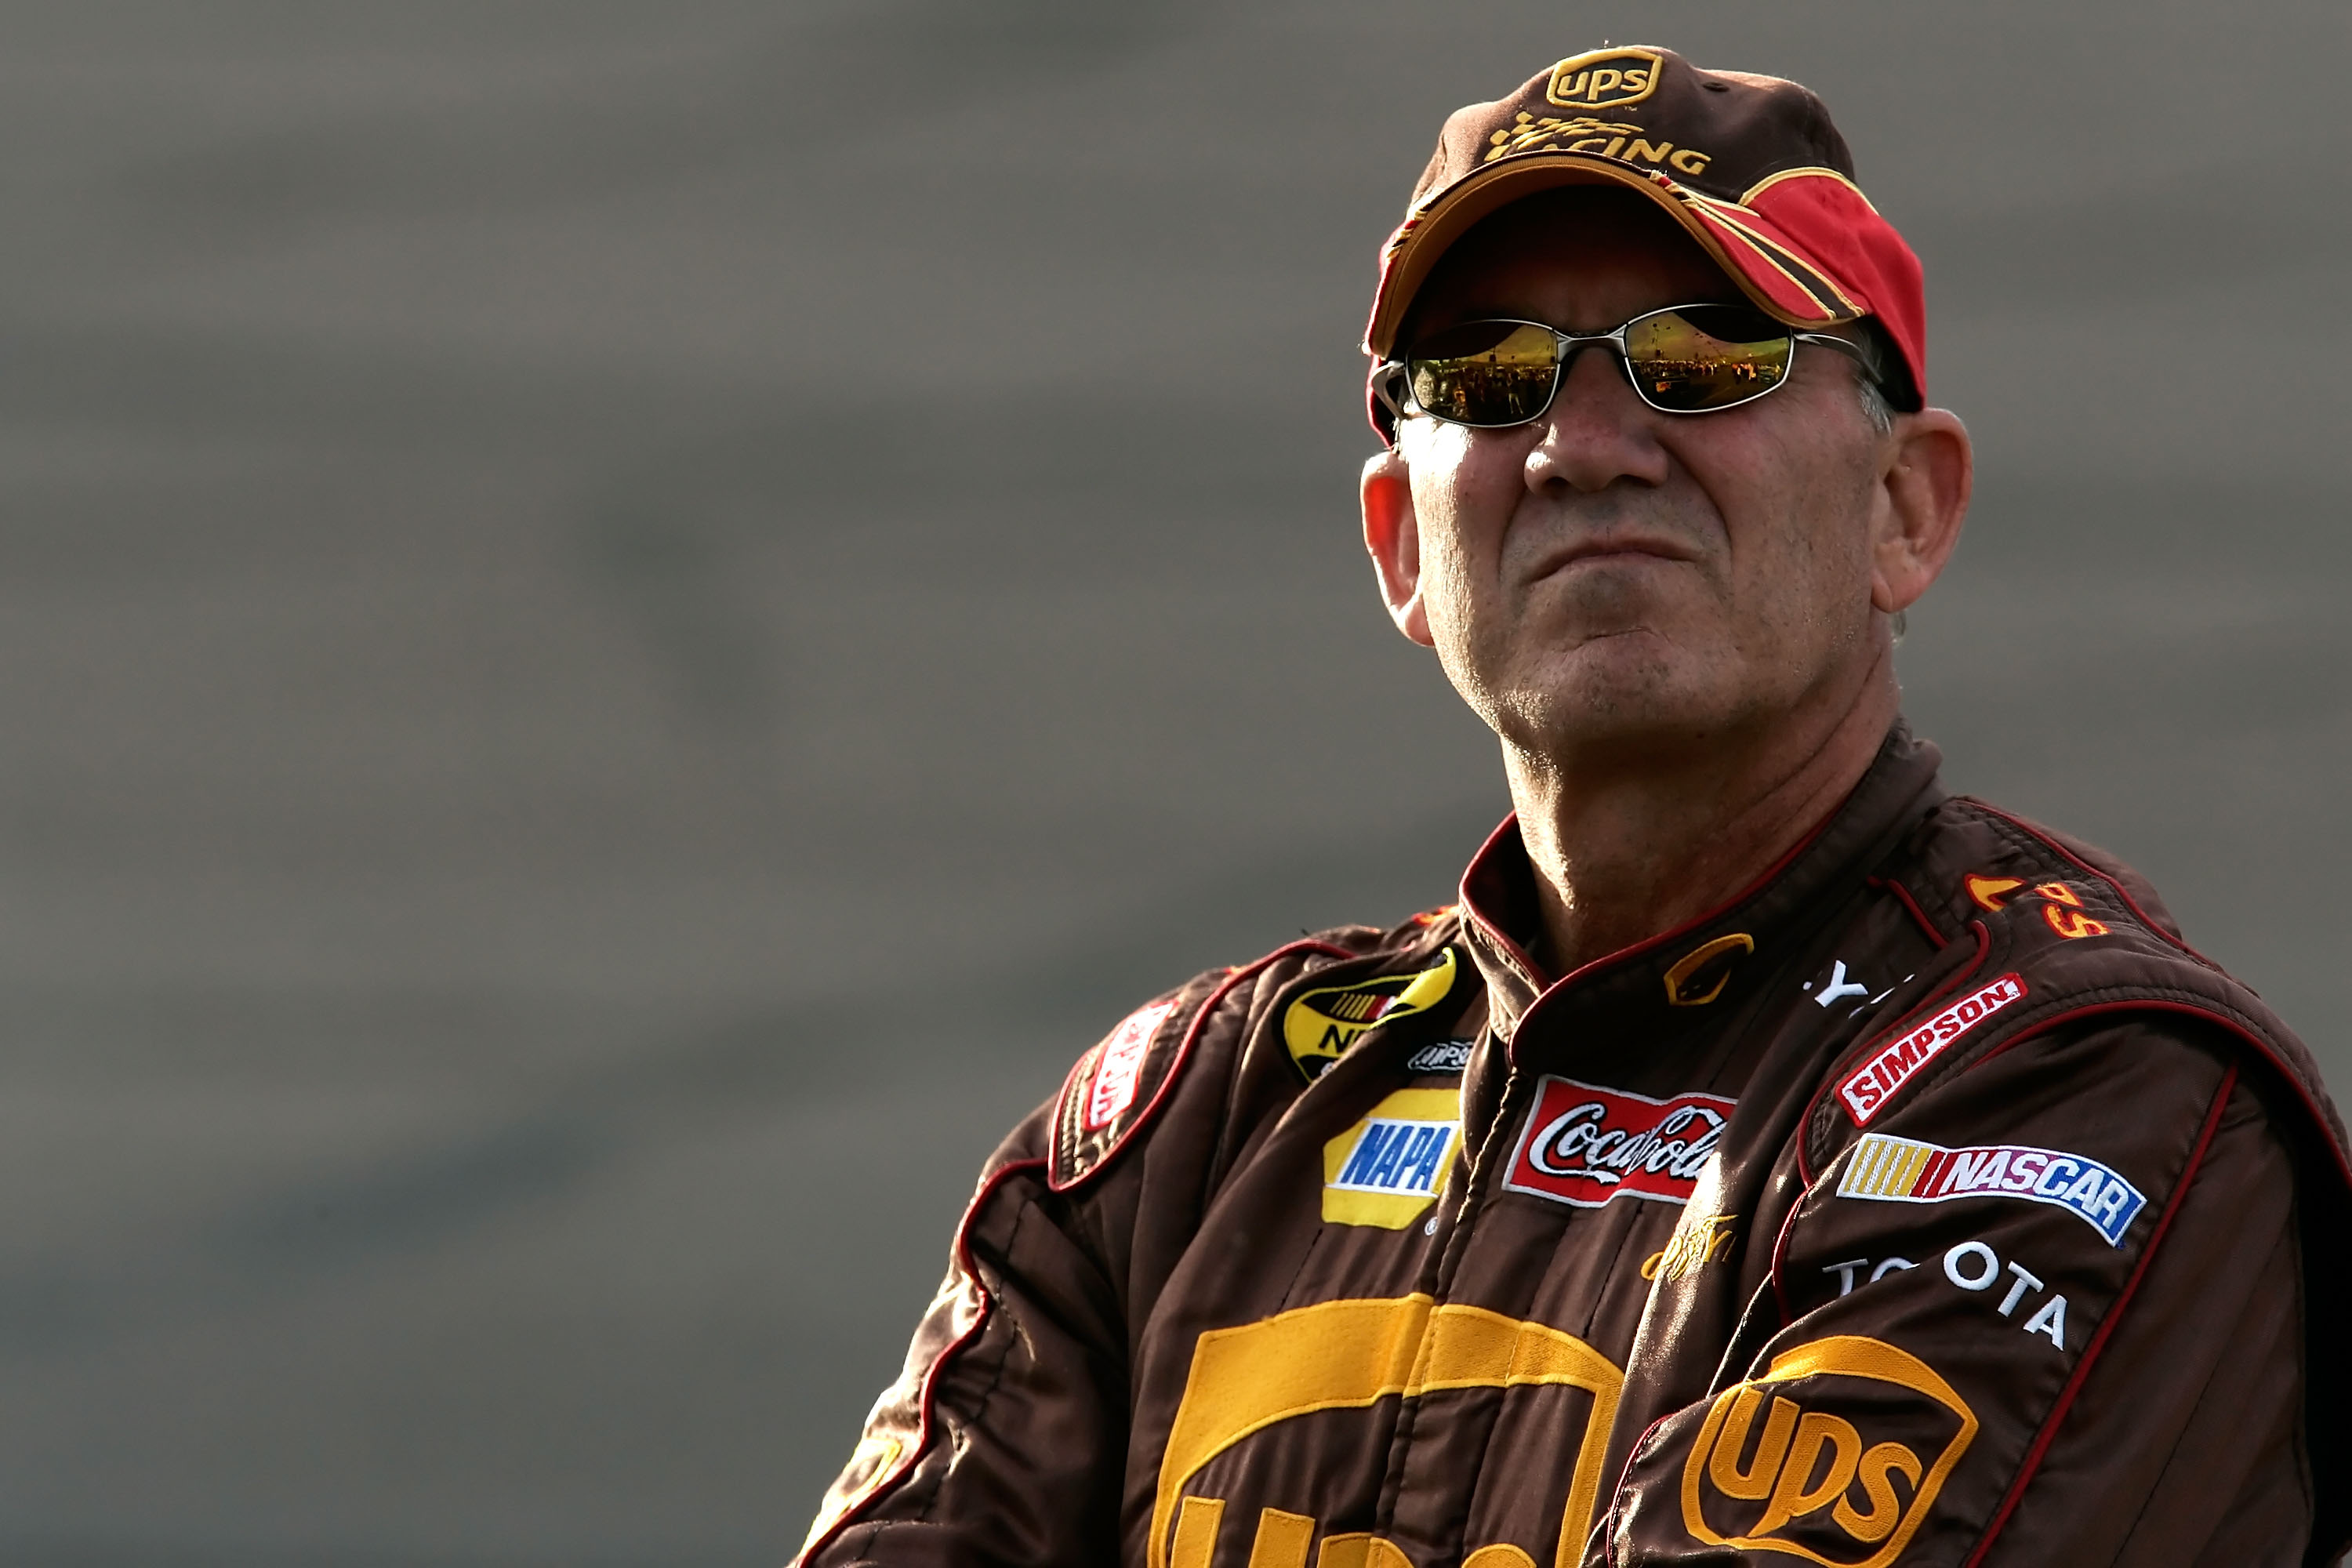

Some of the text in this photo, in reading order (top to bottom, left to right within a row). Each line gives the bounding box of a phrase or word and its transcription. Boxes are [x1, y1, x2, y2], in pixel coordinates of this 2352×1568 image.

[1556, 68, 1649, 101] ups
[1484, 136, 1711, 176] ING
[1852, 984, 2009, 1110] SIMPSON
[1339, 1123, 1451, 1190] NAPA
[1529, 1103, 1727, 1184] CocaCol
[1939, 1149, 2129, 1230] NASCAR
[1821, 1240, 2068, 1352] TOTA
[1708, 1388, 1923, 1543] ups
